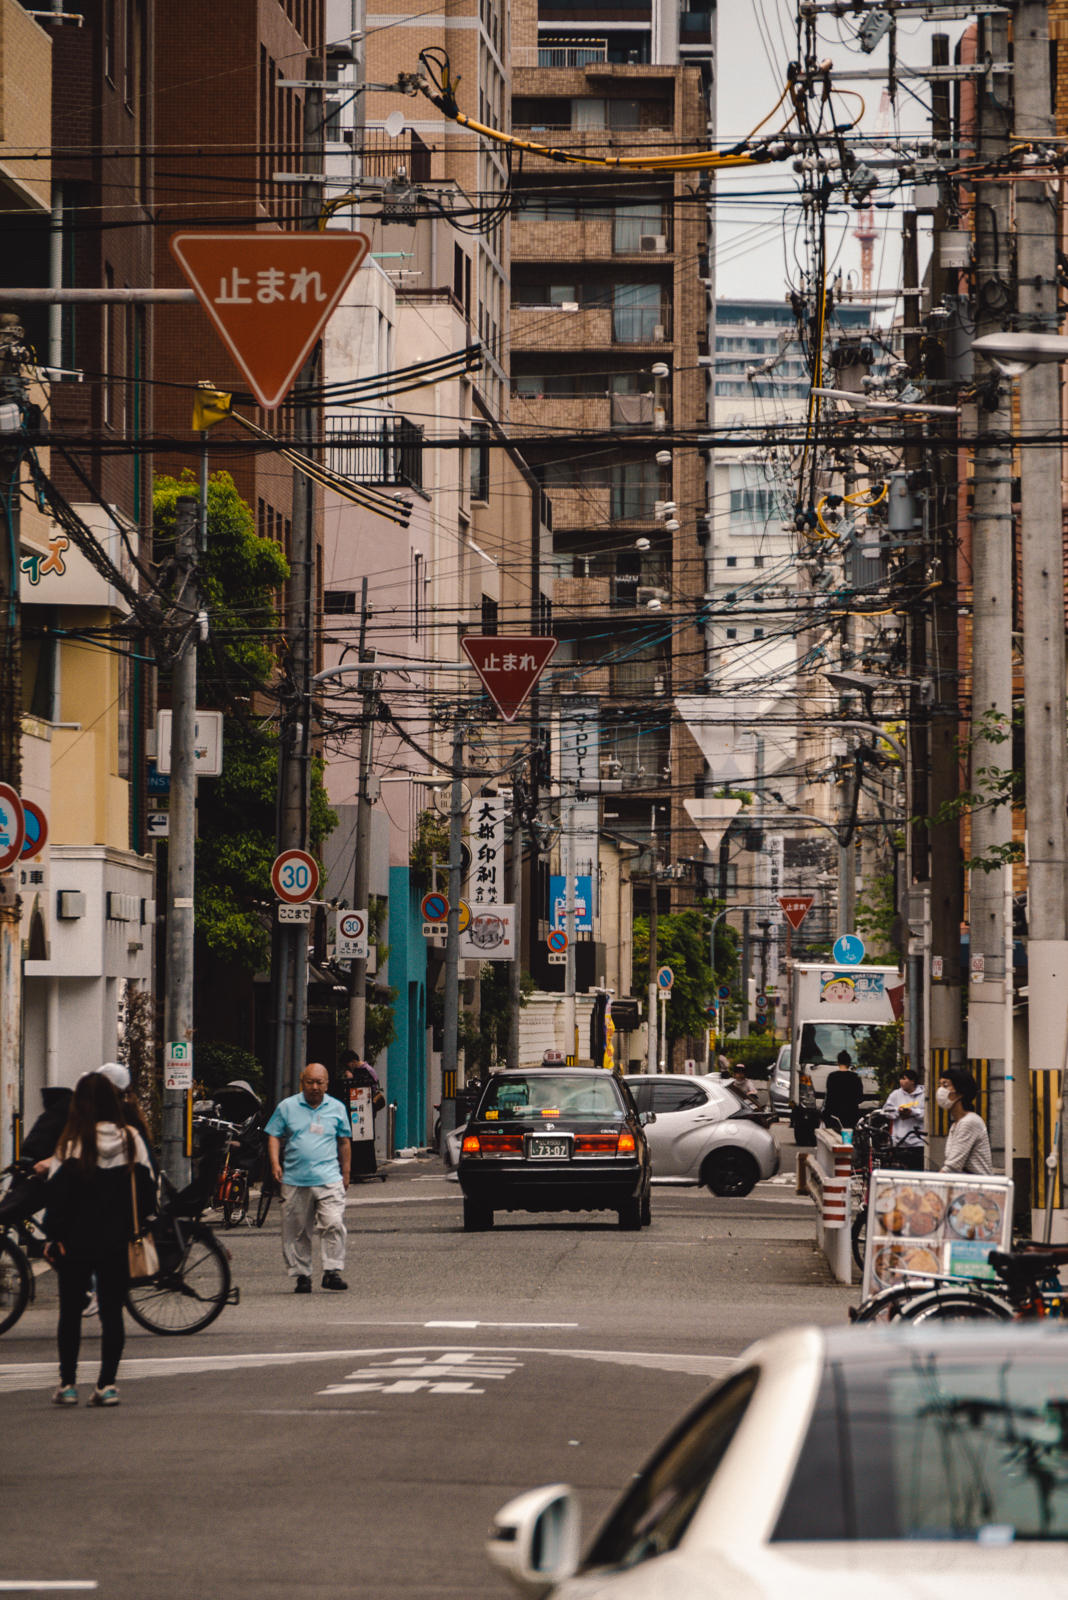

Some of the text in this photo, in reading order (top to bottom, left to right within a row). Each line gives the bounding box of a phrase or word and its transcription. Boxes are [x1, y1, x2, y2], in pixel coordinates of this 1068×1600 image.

[214, 267, 327, 304] 止まれ
[482, 653, 538, 671] 止まれ
[282, 865, 308, 889] 30
[280, 909, 310, 919] ここまで
[345, 921, 359, 932] 30
[538, 1145, 566, 1156] 73-07
